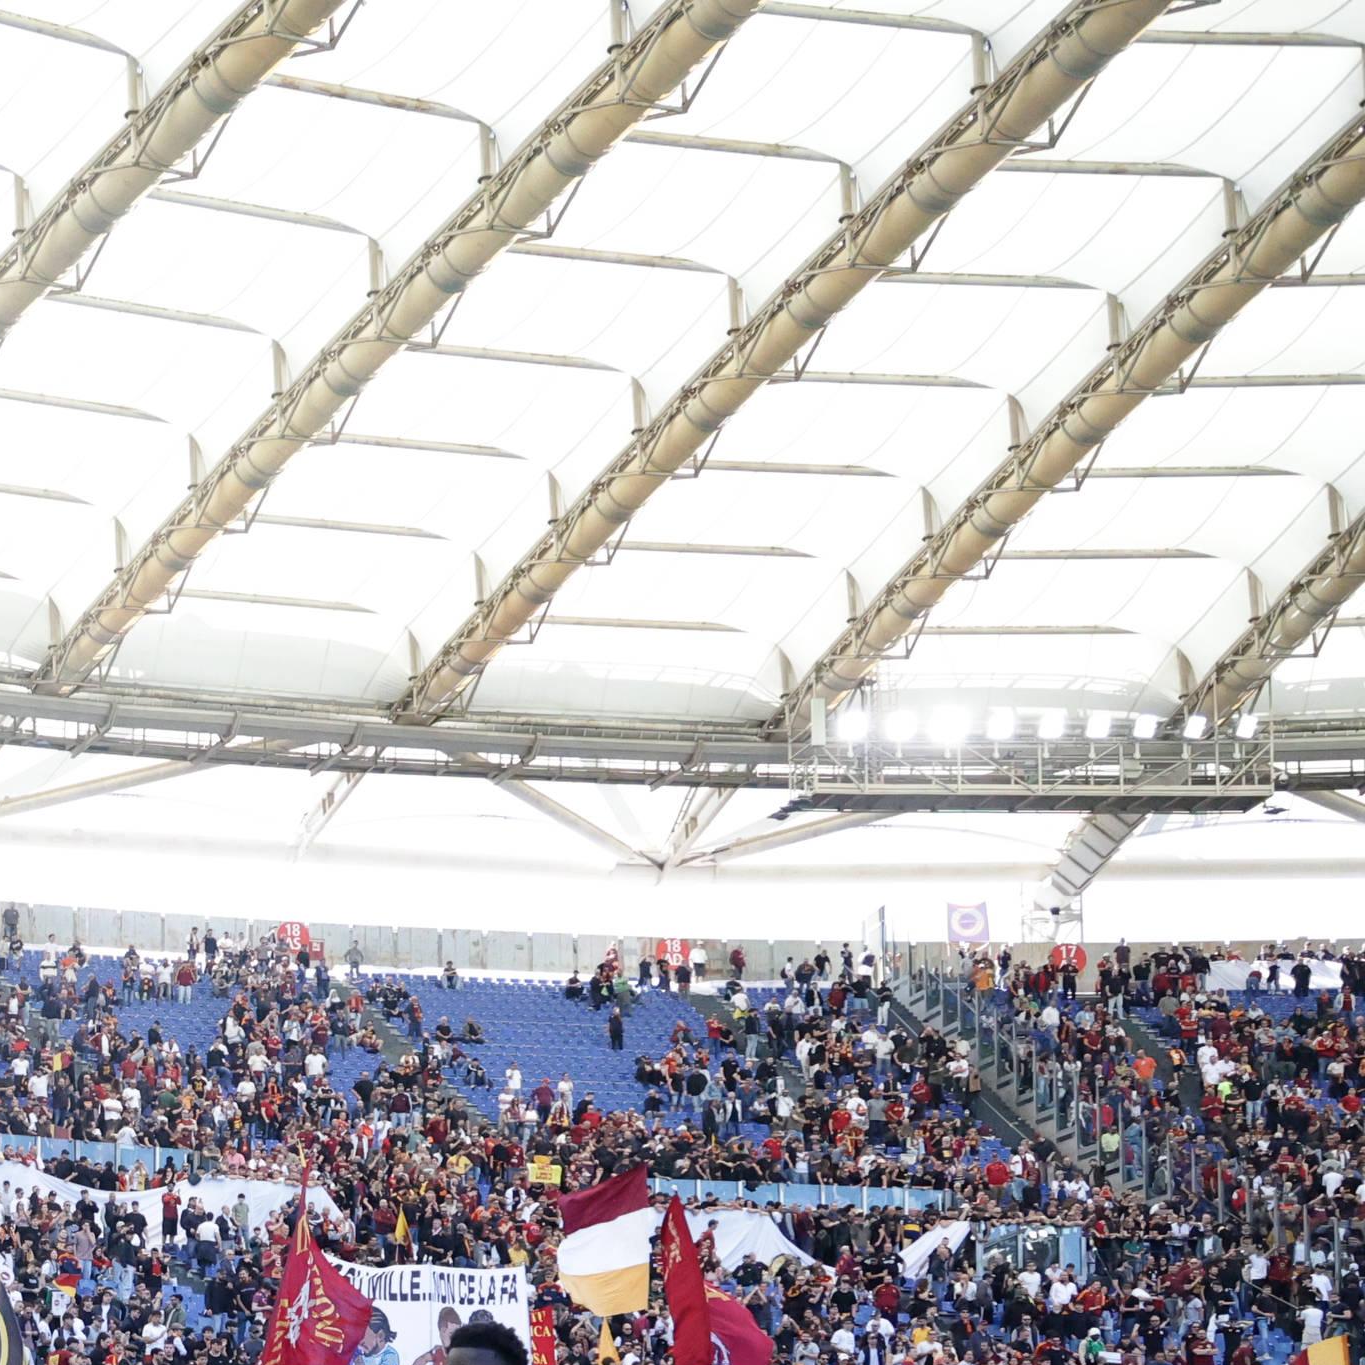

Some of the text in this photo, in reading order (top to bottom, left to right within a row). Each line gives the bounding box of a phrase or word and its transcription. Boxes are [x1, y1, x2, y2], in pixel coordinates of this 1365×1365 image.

[285, 923, 300, 937] 18
[665, 939, 681, 953] 18
[1059, 945, 1077, 958] 17
